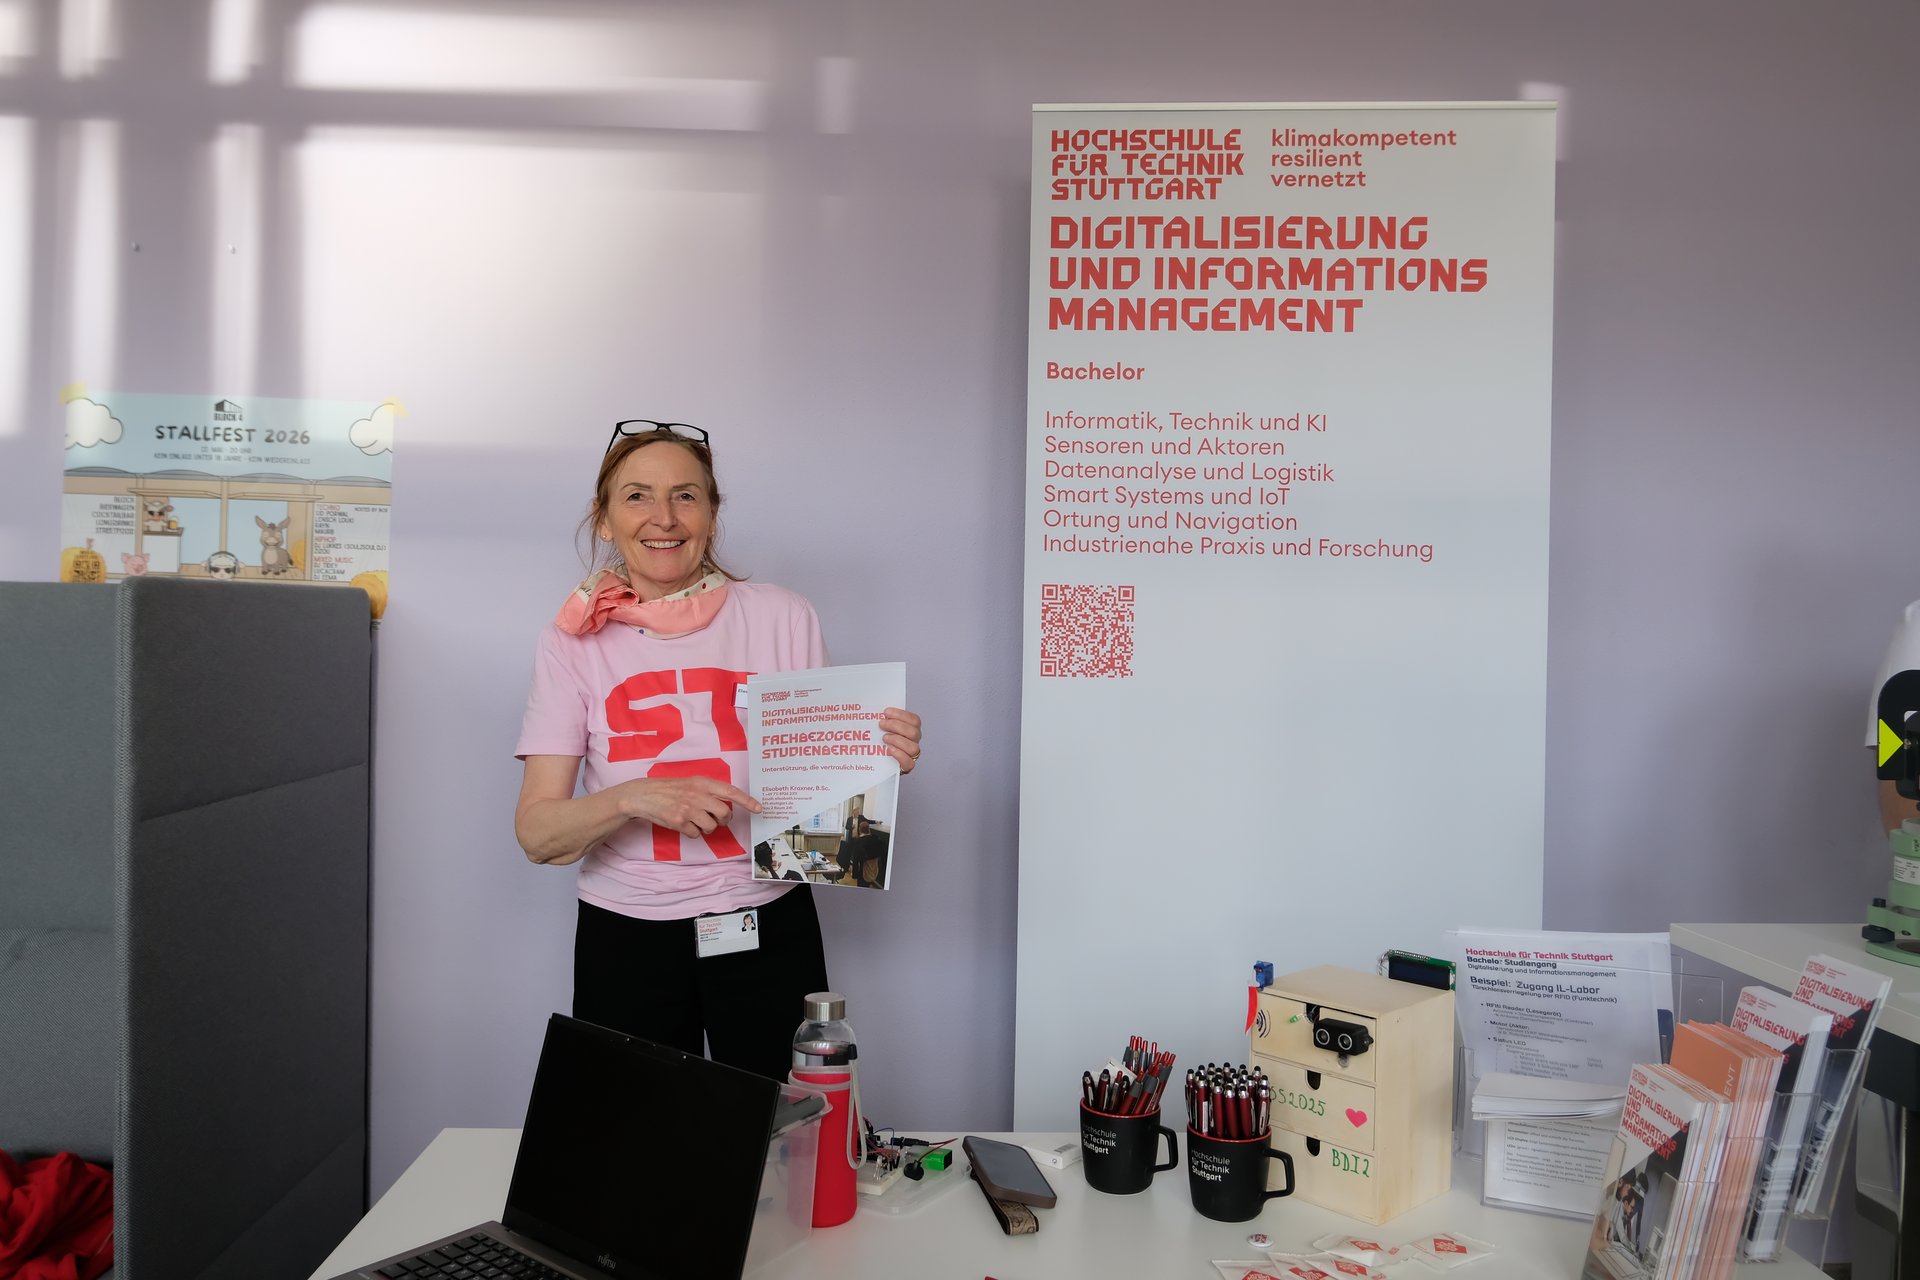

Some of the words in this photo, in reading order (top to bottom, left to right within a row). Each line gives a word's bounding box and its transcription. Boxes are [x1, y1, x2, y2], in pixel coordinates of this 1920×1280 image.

[1052, 129, 1241, 151] HOCHSCHULE
[1271, 129, 1457, 149] klimakompetent
[1052, 154, 1108, 175] FÜR
[1122, 154, 1244, 176] TECHNIK
[1271, 150, 1362, 167] resilient
[1271, 171, 1366, 187] vernetzt
[1052, 178, 1222, 200] STUTTGART
[1050, 216, 1428, 249] DIGITALISIERUNG
[1050, 257, 1141, 289] UND
[1154, 257, 1488, 292] INFORMATIONS
[1048, 298, 1363, 332] MANAGEMENT
[1046, 362, 1145, 381] Bachelor
[1045, 411, 1163, 432] Informatik,
[1168, 412, 1254, 431] Technik
[1259, 414, 1300, 432] und
[1306, 415, 1327, 432] KI
[155, 426, 256, 442] STALLFEST
[264, 430, 310, 445] 2026
[1045, 436, 1144, 455] Sensoren
[1151, 438, 1191, 455] und
[1197, 439, 1285, 456] Aktoren
[1045, 461, 1196, 483] Datenanalyse
[1203, 463, 1244, 481] und
[1252, 463, 1335, 485] Logistik
[1044, 486, 1109, 504] Smart
[1114, 486, 1204, 508] Systems
[1211, 488, 1252, 505] und
[1259, 488, 1290, 506] IoT
[1043, 510, 1120, 532] Ortung
[1127, 512, 1168, 529] und
[1175, 512, 1298, 534] Navigation
[1043, 535, 1193, 554] Industrienahe
[1200, 537, 1265, 556] Praxis
[1272, 538, 1312, 557] und
[1318, 539, 1434, 563] Forschung
[762, 704, 840, 718] DIGITALISIERUNG
[762, 730, 871, 746] FACHBEZOGENE
[762, 765, 808, 773] Unterstützung,
[809, 764, 820, 772] die
[820, 764, 854, 772] vertraulich
[856, 764, 874, 772] bleibt.
[1466, 948, 1517, 958] Hochschule
[1519, 951, 1531, 959] für
[1533, 952, 1569, 960] Technik
[1571, 953, 1614, 962] Stuttgart
[1504, 958, 1557, 969] Studiengang
[1529, 968, 1617, 978] Informationsmanagement
[1470, 976, 1511, 988] Beispiel:
[1516, 981, 1554, 994] Zugang
[1556, 984, 1600, 995] IL-Labor
[1795, 986, 1813, 1000] UND
[1799, 976, 1874, 1012] DIGITALISIERUNG
[1543, 992, 1553, 1000] per
[1572, 995, 1618, 1004] (Funktechnik)
[1732, 1020, 1748, 1033] UND
[1735, 1007, 1808, 1046] DIGITALISIERUNG
[1626, 1095, 1641, 1112] UND
[1628, 1085, 1689, 1133] DIGITALISIERUNG
[1623, 1106, 1678, 1152] INFORMATIONS
[1083, 1138, 1109, 1154] Stuttgart
[1090, 1134, 1117, 1147] Technik
[1622, 1117, 1672, 1161] MANAGEMENT
[1192, 1165, 1222, 1182] Stuttgart
[1200, 1160, 1230, 1174] Technik
